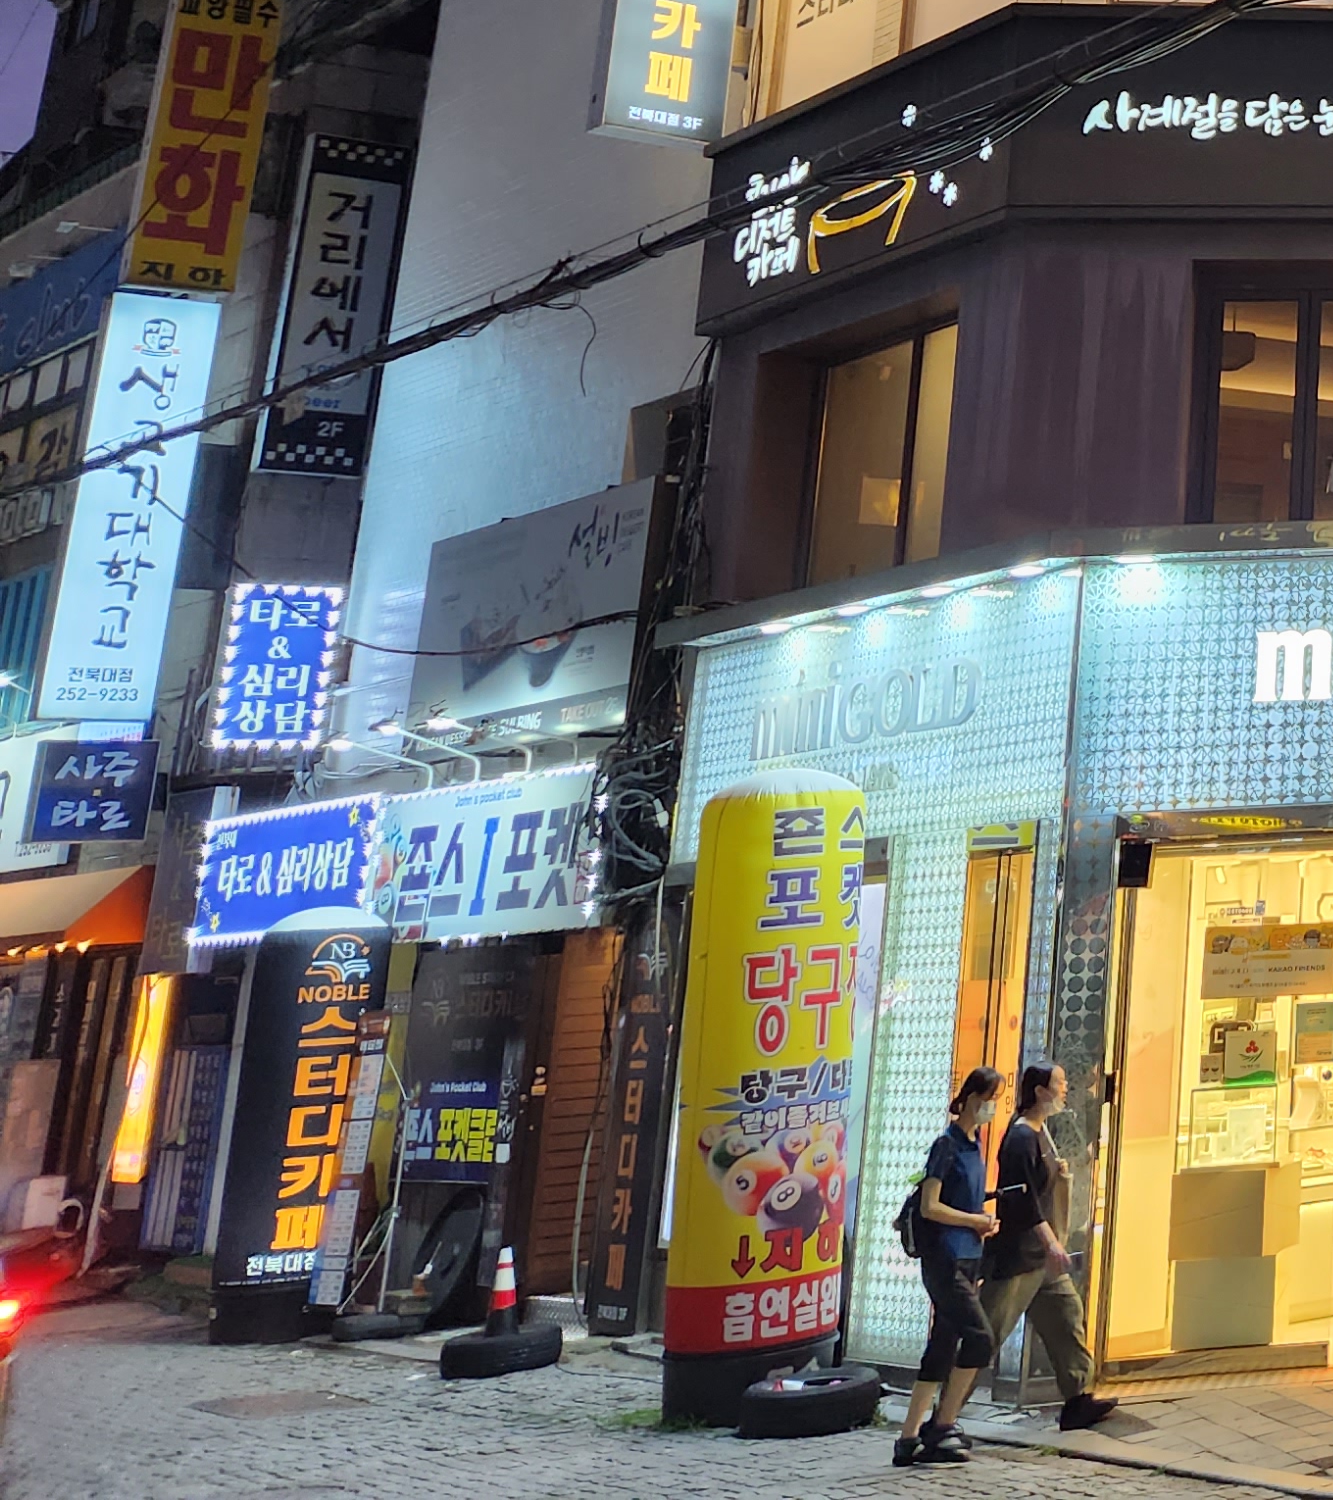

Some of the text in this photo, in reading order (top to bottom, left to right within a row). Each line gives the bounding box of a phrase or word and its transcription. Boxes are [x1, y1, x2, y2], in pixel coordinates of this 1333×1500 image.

[682, 114, 703, 130] 3F
[1083, 91, 1238, 138] 사계절을
[1246, 92, 1309, 133] 담은
[142, 28, 277, 257] 만화
[139, 260, 228, 288] 지하
[303, 191, 374, 351] 거리에서
[745, 240, 800, 288] 카페
[317, 421, 344, 439] 2F
[249, 595, 320, 633] 타로
[267, 635, 291, 661] &
[68, 666, 133, 684] 전북대점
[237, 663, 310, 701] 심리
[56, 687, 139, 702] 252-9233
[230, 700, 309, 736] 상담
[54, 750, 139, 787] 사주
[507, 787, 523, 800] club
[50, 800, 132, 830] 타로
[773, 806, 865, 858] 존스
[219, 837, 355, 902] 타로 & 심리상담
[395, 801, 584, 923] 존스 포켓
[759, 864, 863, 930] 포켓
[298, 984, 371, 1004] NOBLE
[740, 1060, 852, 1104] 당구/다
[271, 1006, 357, 1251] 스터디카페
[736, 1174, 749, 1190] 5
[777, 1188, 795, 1203] 8
[722, 1275, 840, 1342] 흡연실완
